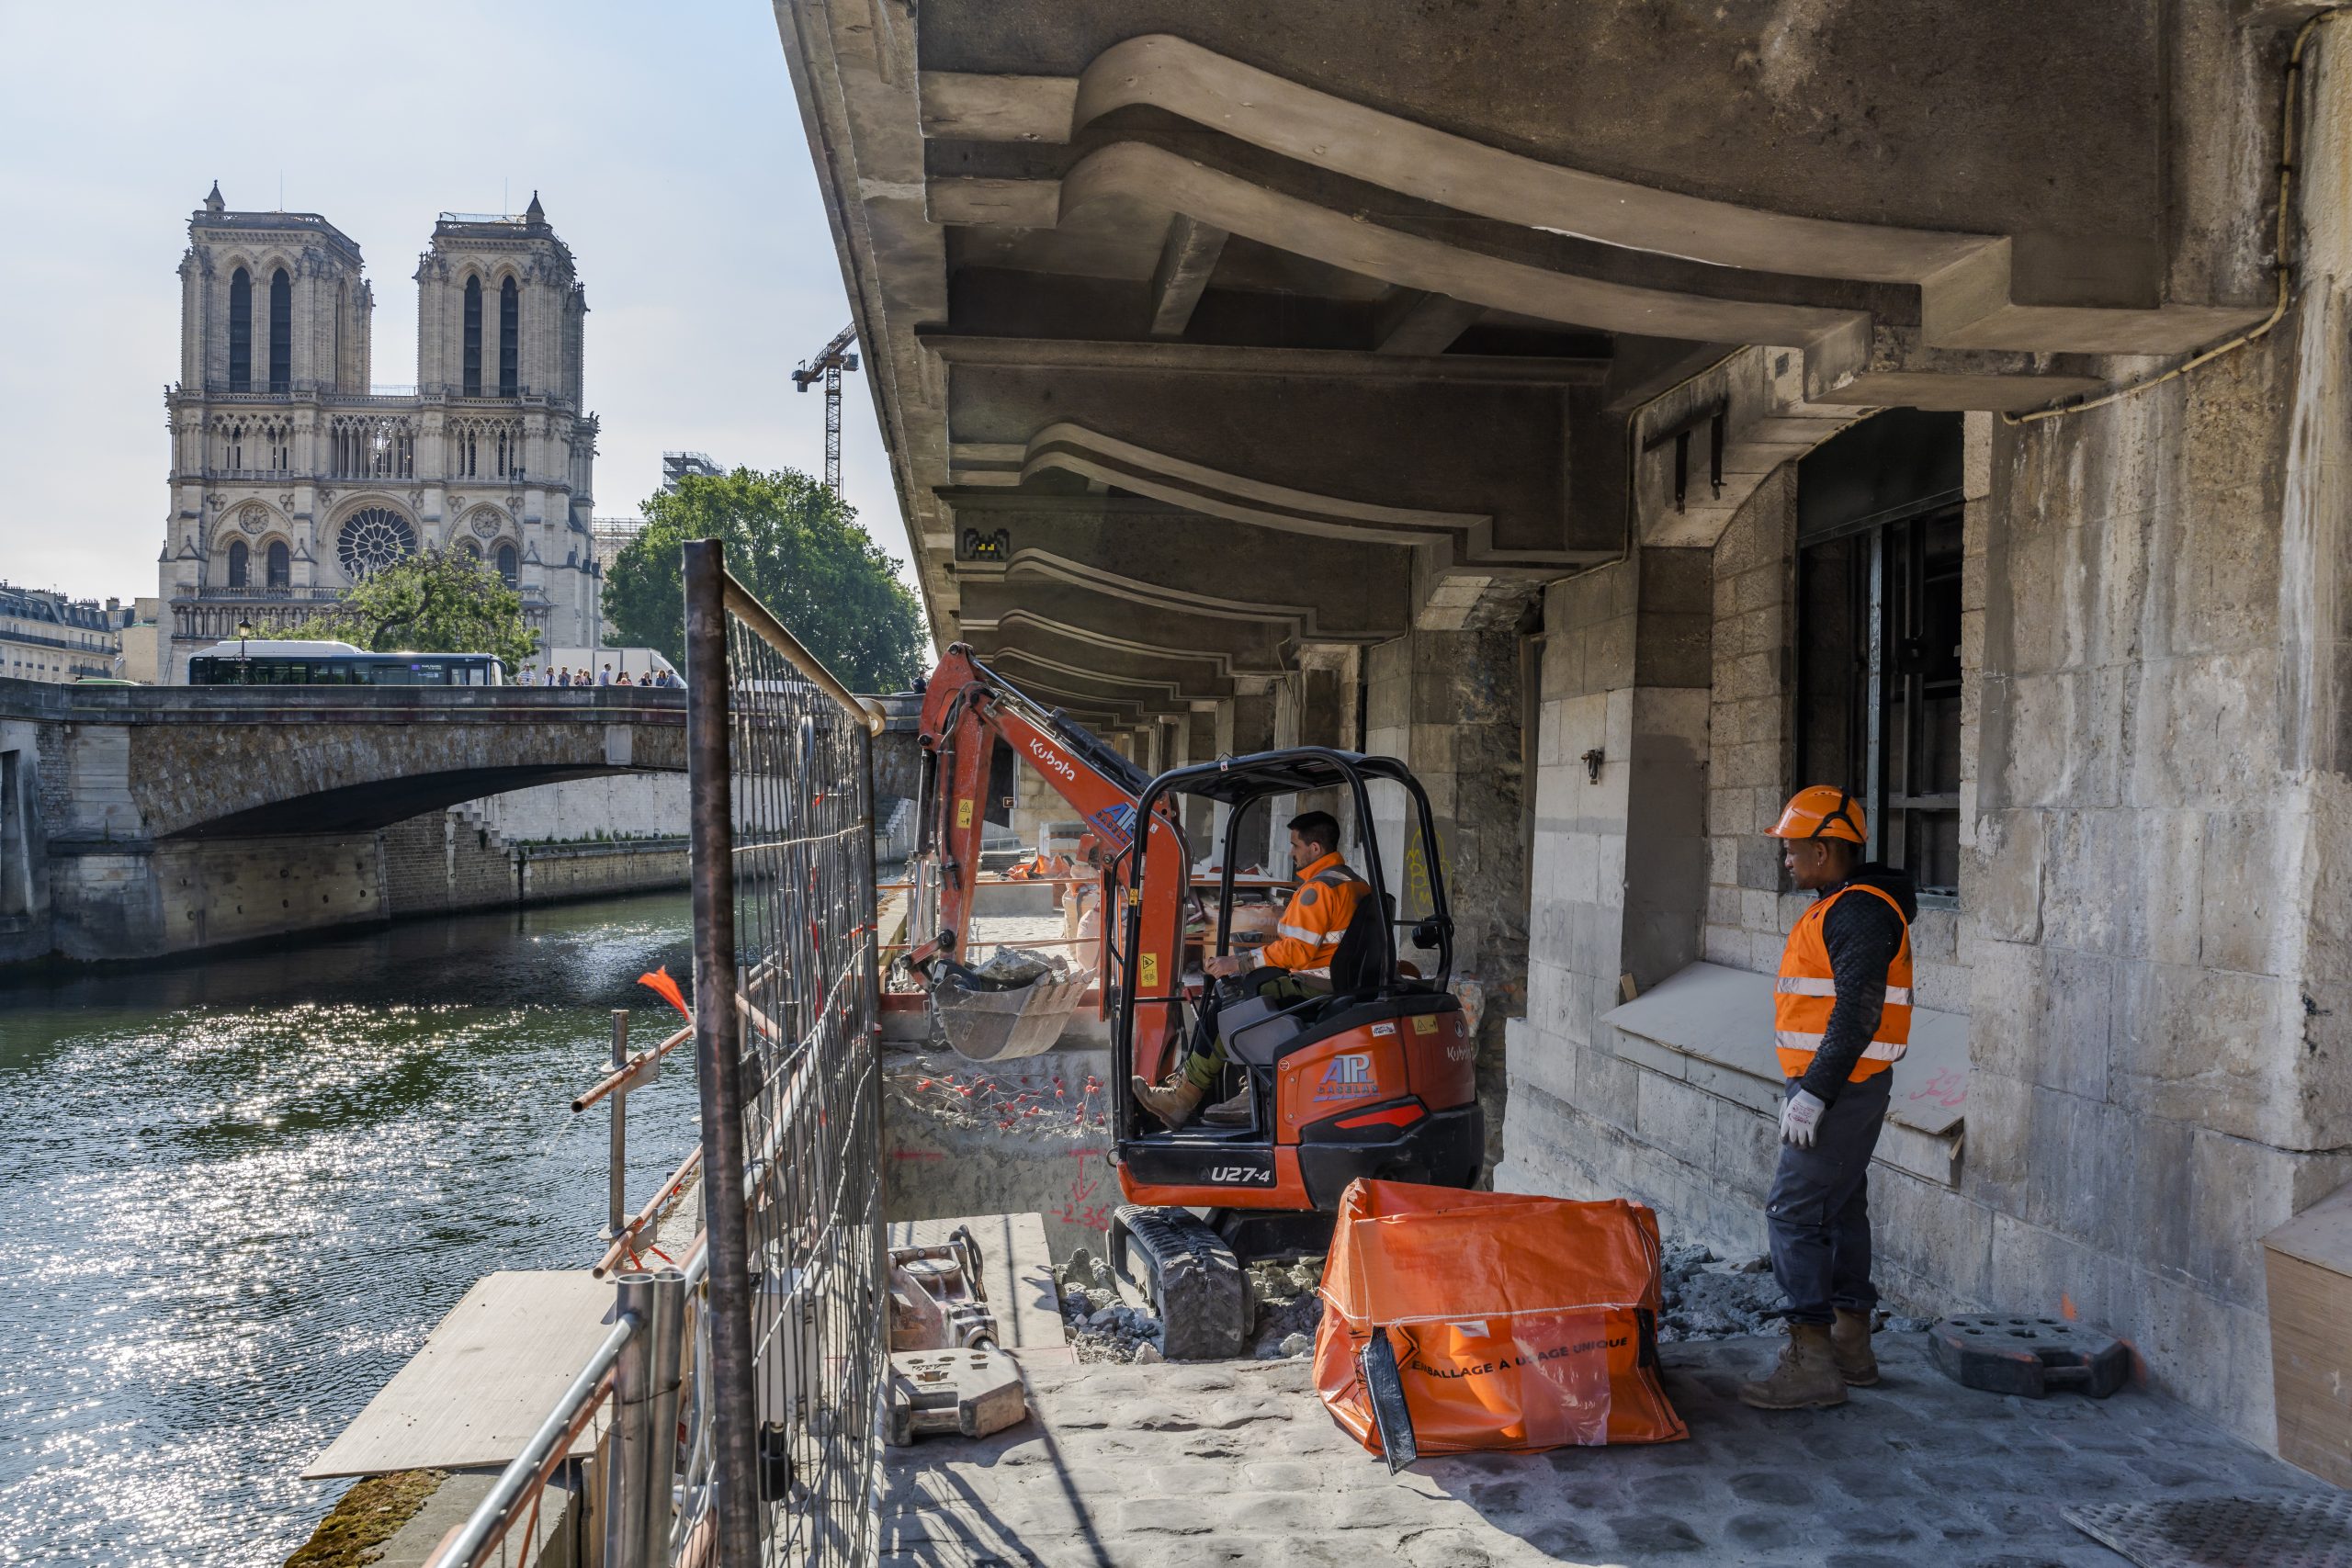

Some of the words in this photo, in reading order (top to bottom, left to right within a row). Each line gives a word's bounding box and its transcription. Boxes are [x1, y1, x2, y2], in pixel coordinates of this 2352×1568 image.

[1029, 738, 1075, 782] Kubota
[1211, 1167, 1271, 1182] U27-4
[1499, 1358, 1510, 1371] À
[1516, 1347, 1569, 1367] UAGE
[1573, 1337, 1628, 1355] UNIQUE
